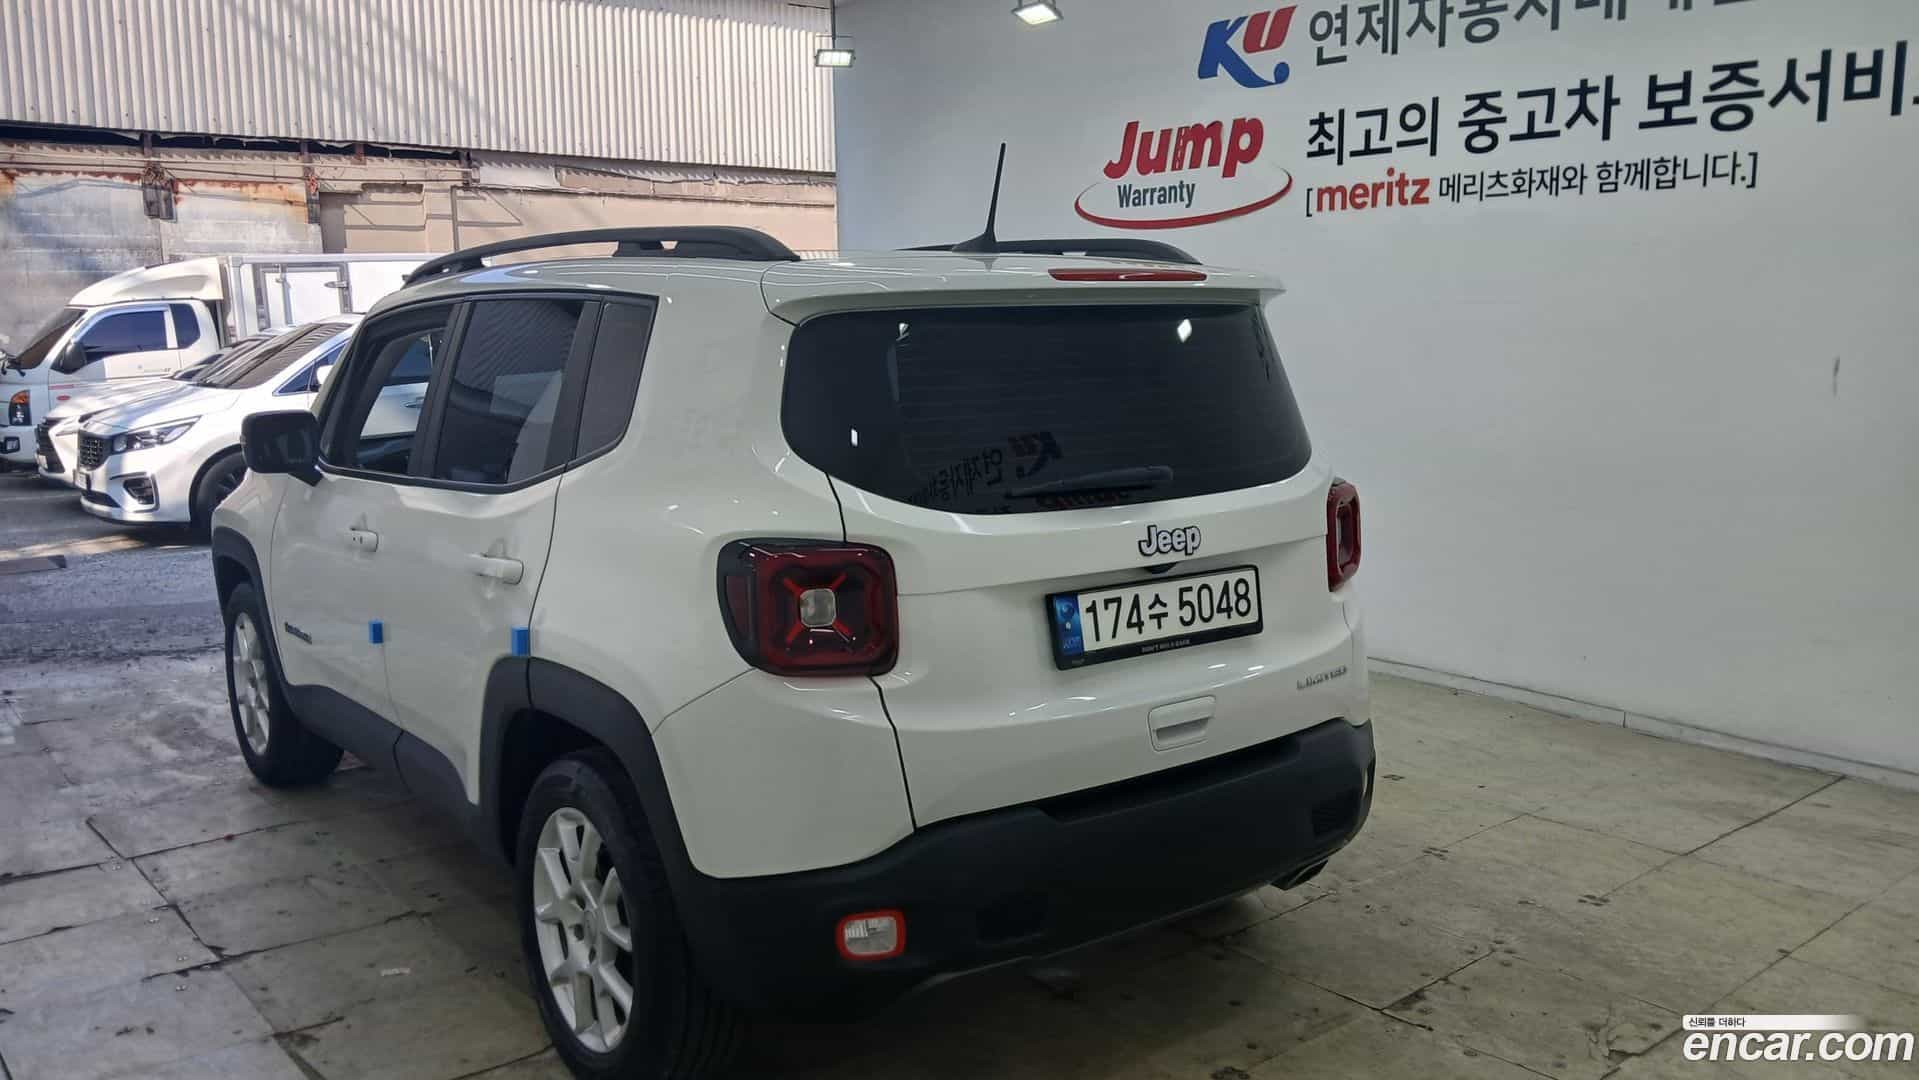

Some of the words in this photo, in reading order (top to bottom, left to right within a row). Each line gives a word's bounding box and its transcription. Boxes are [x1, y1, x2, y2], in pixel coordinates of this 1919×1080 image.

[1306, 96, 1440, 165] 최고의
[1458, 75, 1621, 154] 중고차
[1638, 40, 1919, 133] 보증서비
[1103, 118, 1264, 179] Jump
[1117, 181, 1196, 209] Warranty
[1439, 165, 1588, 203] 메리츠화재와
[1139, 525, 1201, 556] Jeep
[1085, 593, 1169, 642] 174수
[1178, 578, 1251, 627] 5048
